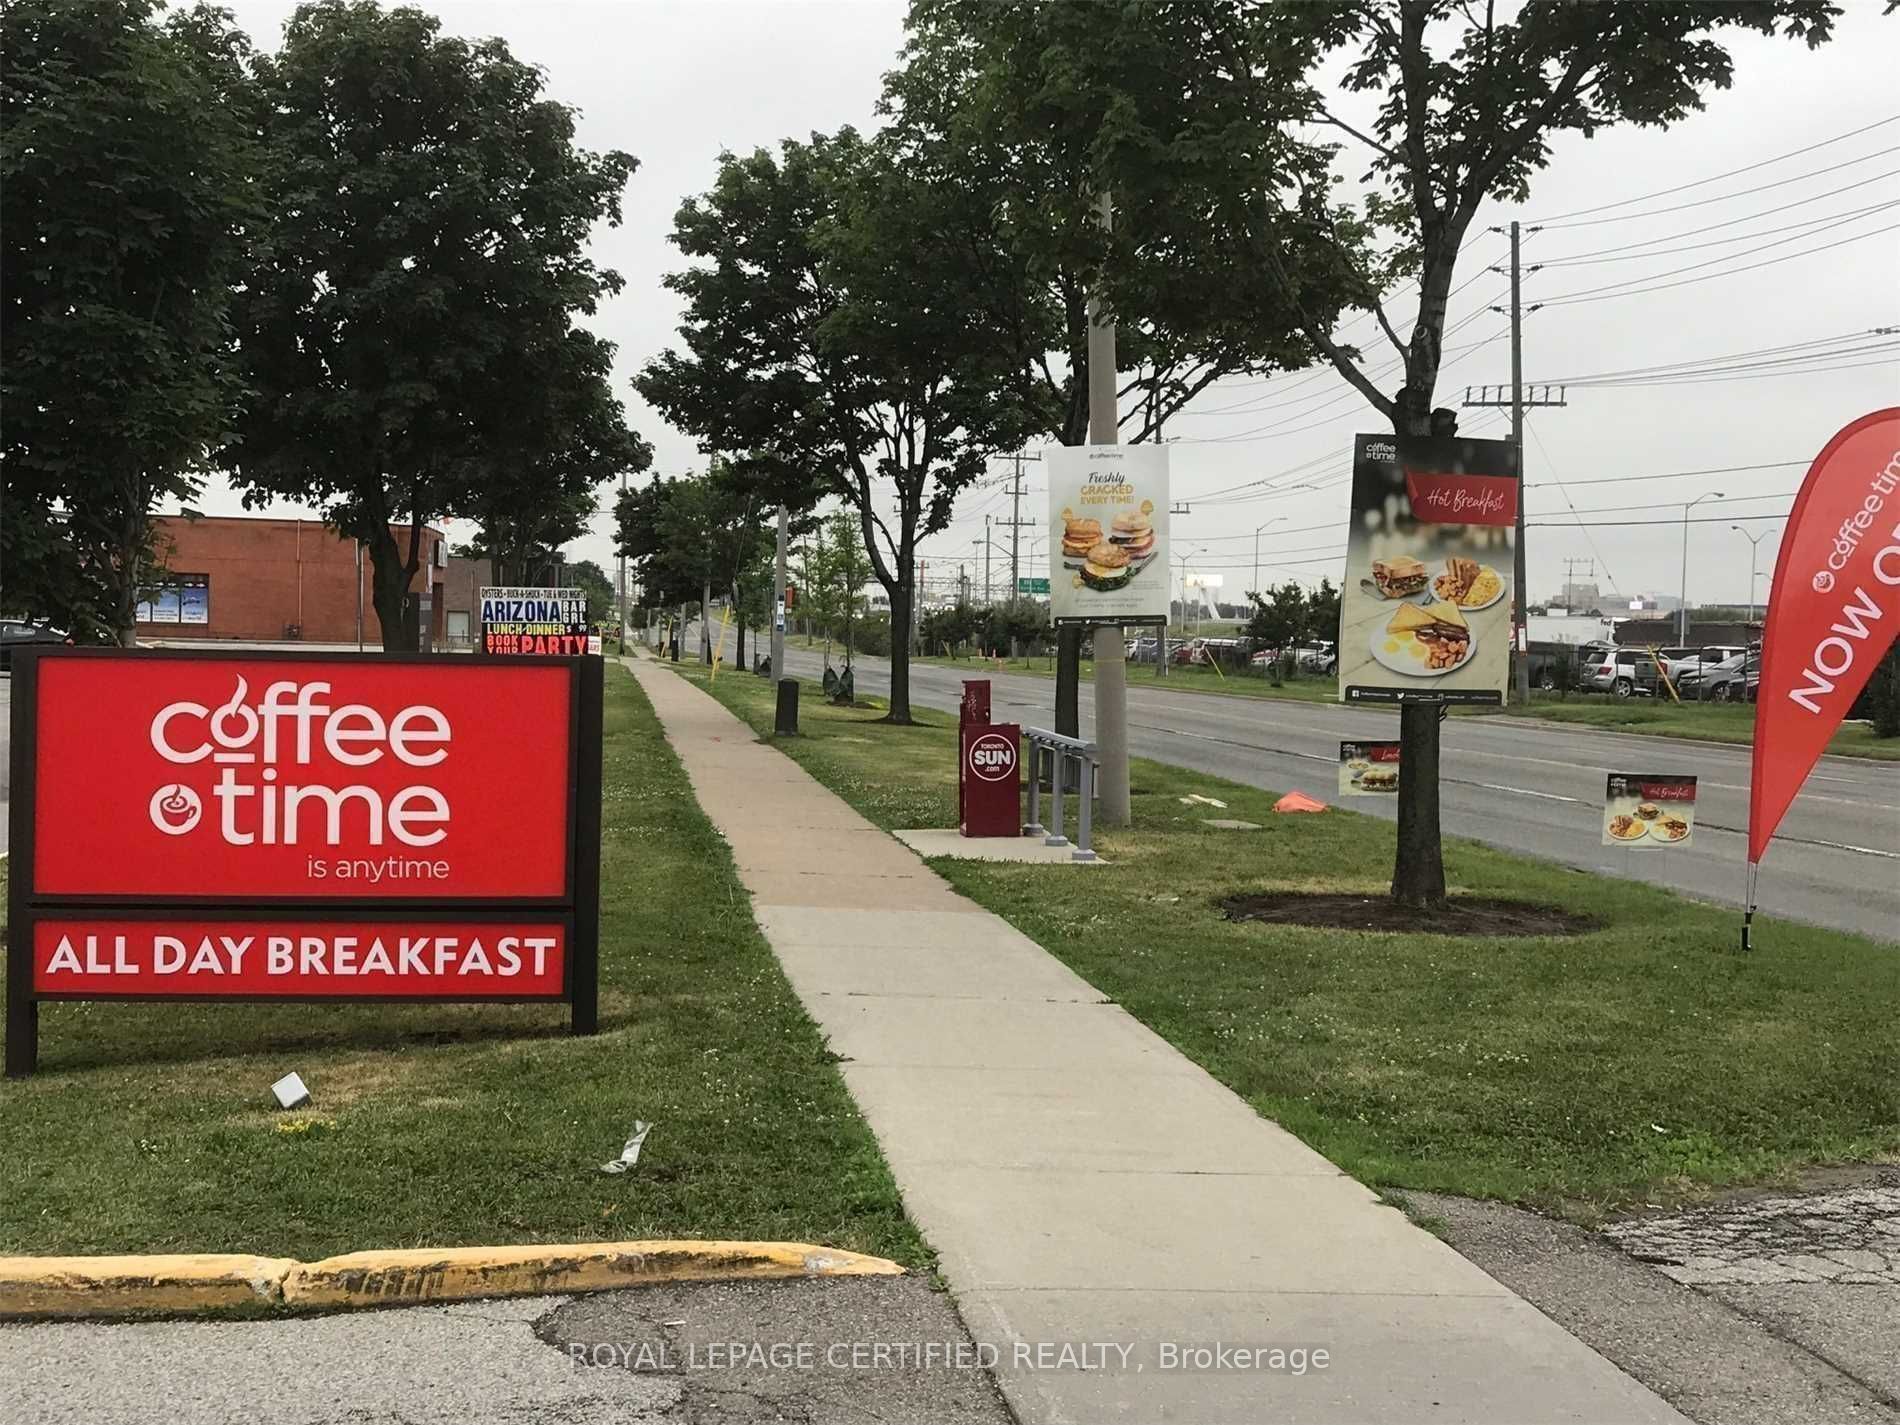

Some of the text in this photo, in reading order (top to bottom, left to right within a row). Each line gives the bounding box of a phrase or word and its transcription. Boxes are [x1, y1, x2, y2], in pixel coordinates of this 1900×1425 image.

[1366, 441, 1396, 452] coffee
[1373, 452, 1396, 460] time
[1088, 471, 1125, 487] Freshly
[1081, 484, 1134, 495] CRACKED
[1081, 496, 1109, 504] EVERY
[1427, 486, 1504, 515] Hot Breakfast
[1828, 450, 1900, 570] coffee tim
[481, 589, 503, 599] OYSTERS
[482, 600, 561, 622] ARIZONA
[563, 601, 586, 612] BAR
[563, 612, 586, 623] GRL
[487, 635, 518, 646] BOOK
[522, 635, 587, 655] PARTY
[487, 646, 518, 654] YOUR
[1788, 586, 1883, 714] NOW
[150, 673, 452, 766] coffee
[974, 750, 1011, 765] SUN
[213, 768, 451, 847] time
[308, 854, 450, 884] is anytime
[46, 935, 556, 977] ALL DAY BREAKFAST
